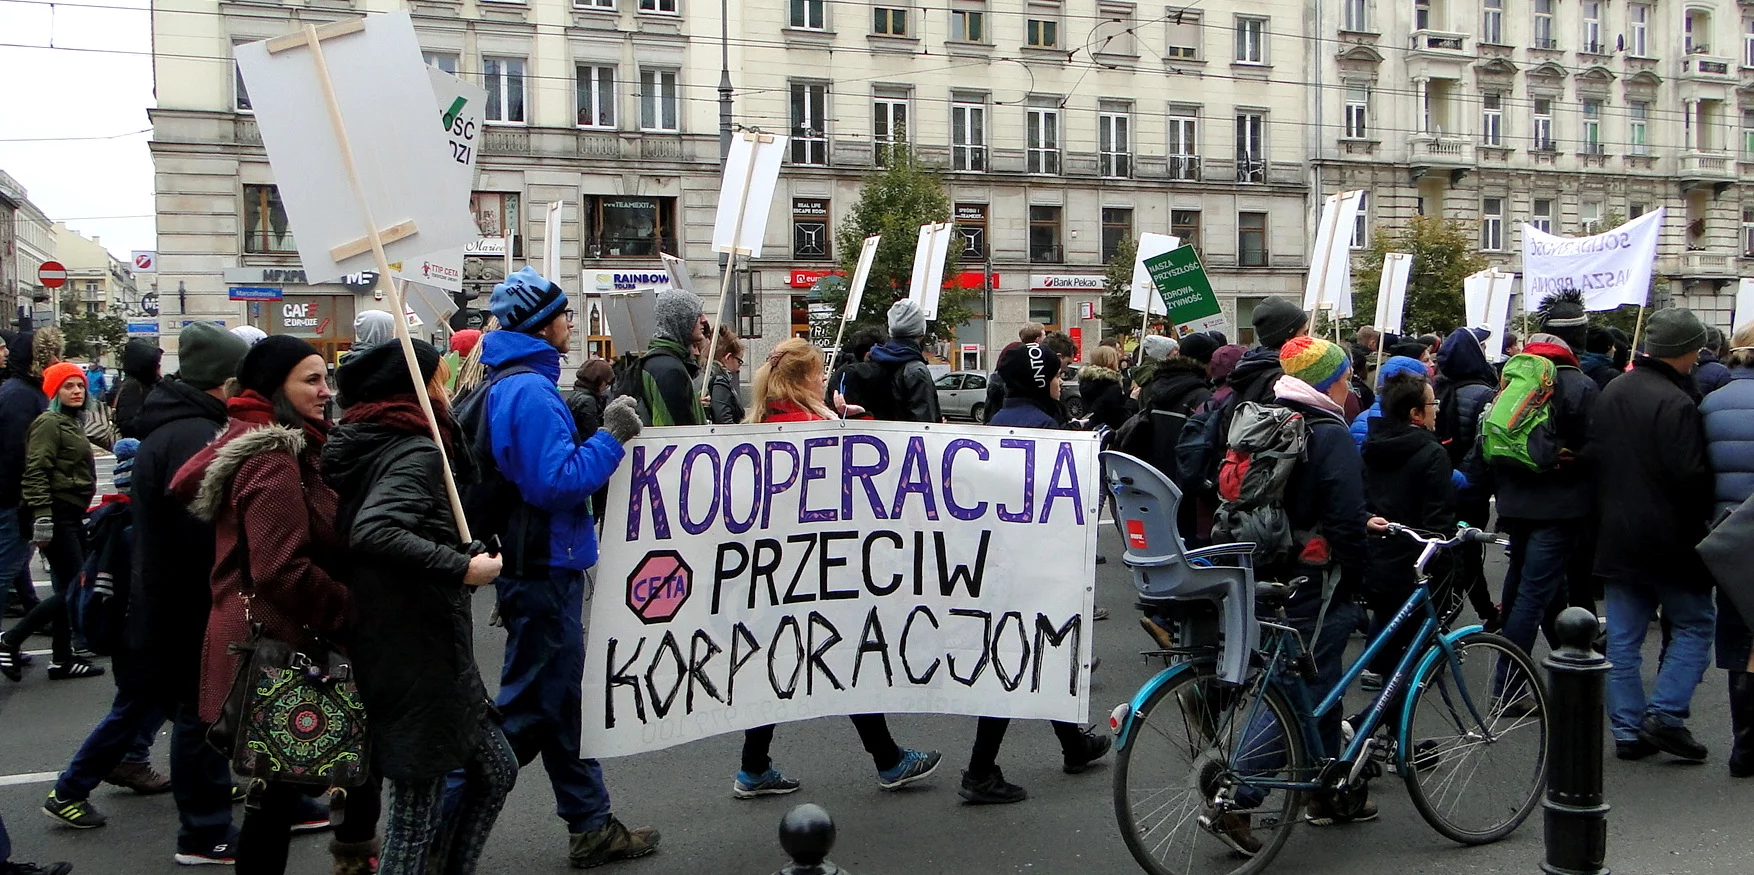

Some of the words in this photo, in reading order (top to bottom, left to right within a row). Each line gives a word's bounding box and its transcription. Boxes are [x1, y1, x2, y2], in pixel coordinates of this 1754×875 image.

[440, 109, 475, 140] OŚĆ
[431, 264, 443, 273] TTIP
[444, 268, 459, 277] CETA
[1148, 259, 1174, 273] NASZA
[1153, 261, 1200, 282] PRZYSZŁOŚĆ
[613, 274, 670, 284] RAINBOW
[1053, 277, 1073, 287] Bank
[1074, 277, 1097, 287] Pekao
[1162, 285, 1194, 301] ZDROWA
[1166, 291, 1203, 310] ŻYWNOŚĆ
[625, 435, 1085, 542] KOOPERACJA
[709, 529, 992, 616] PRZECIW
[632, 573, 686, 605] CETA
[604, 605, 1082, 730] KORPORACJOM
